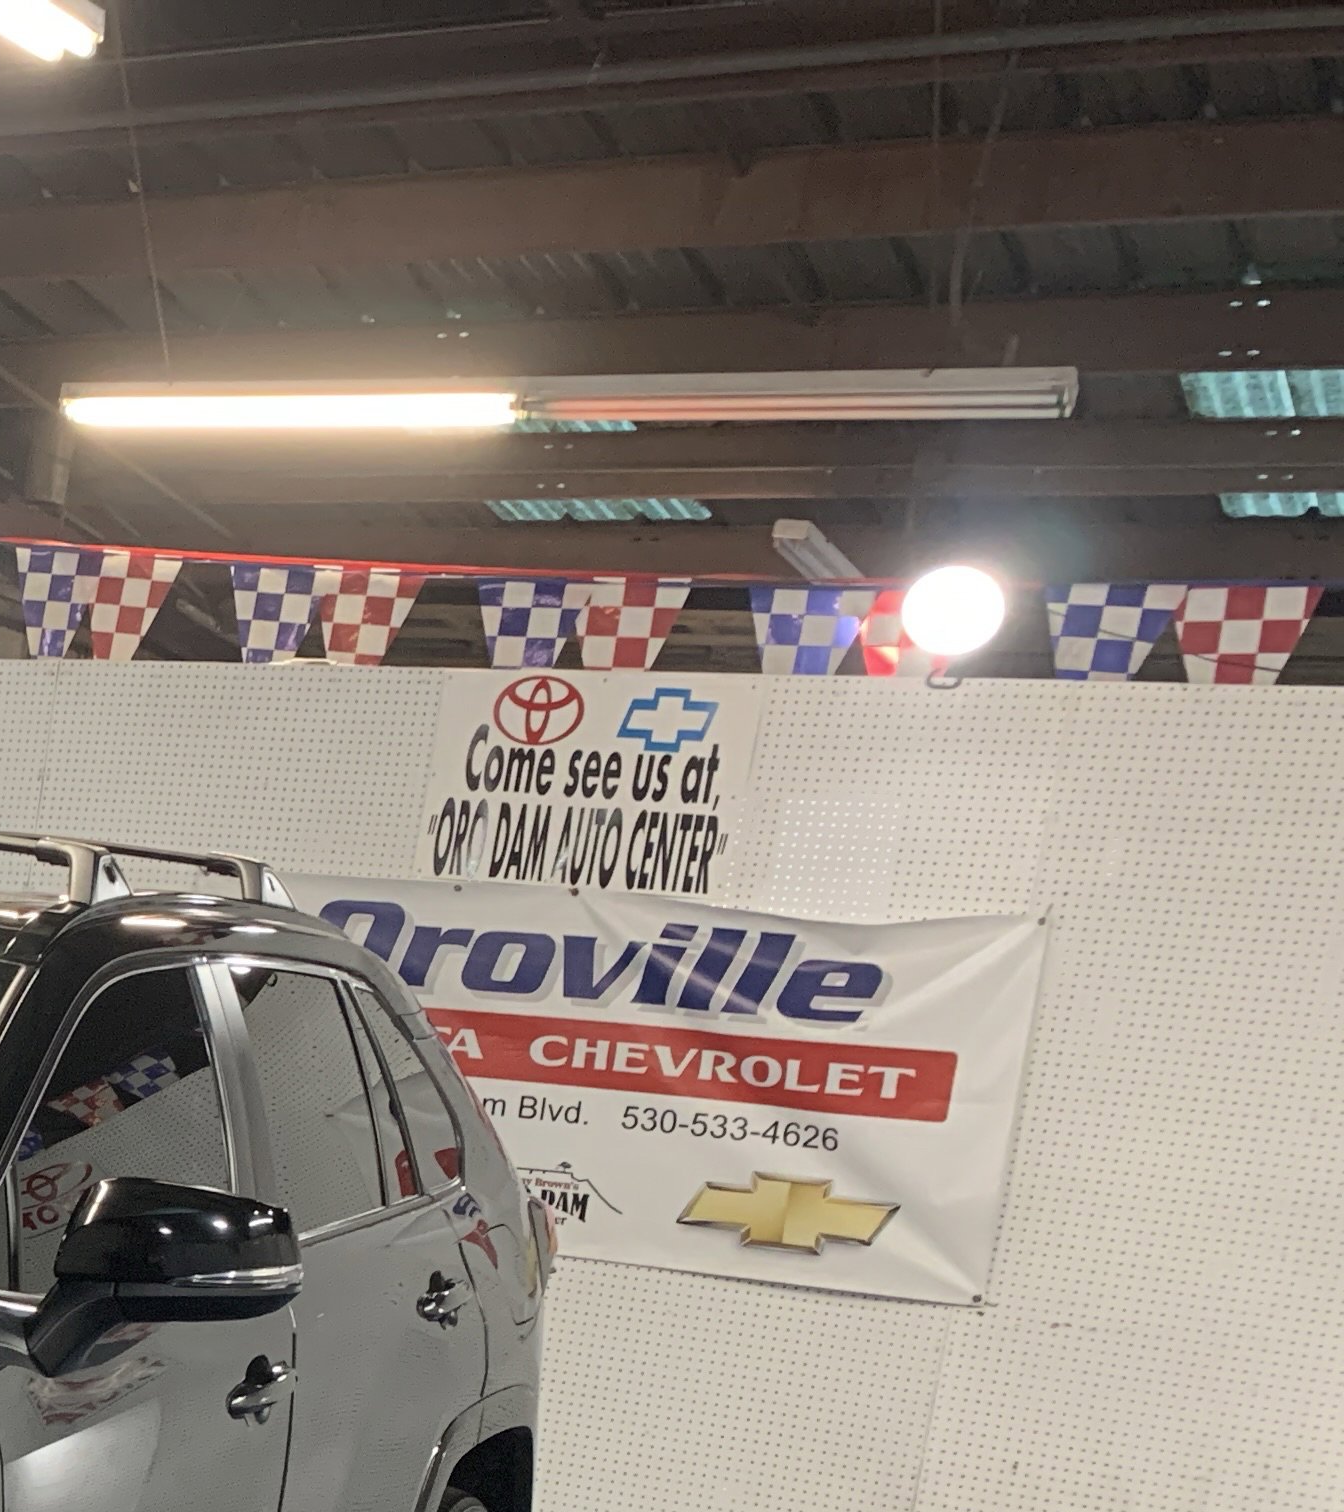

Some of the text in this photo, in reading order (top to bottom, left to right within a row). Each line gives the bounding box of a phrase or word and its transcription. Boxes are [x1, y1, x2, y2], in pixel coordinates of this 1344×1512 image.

[465, 724, 720, 811] Come see us at,
[489, 802, 553, 882] DAM
[551, 806, 624, 889] AUTO
[528, 1035, 916, 1100] CHEVROLET
[518, 1095, 589, 1126] Blvd.
[621, 1105, 839, 1152] 530-533-4626
